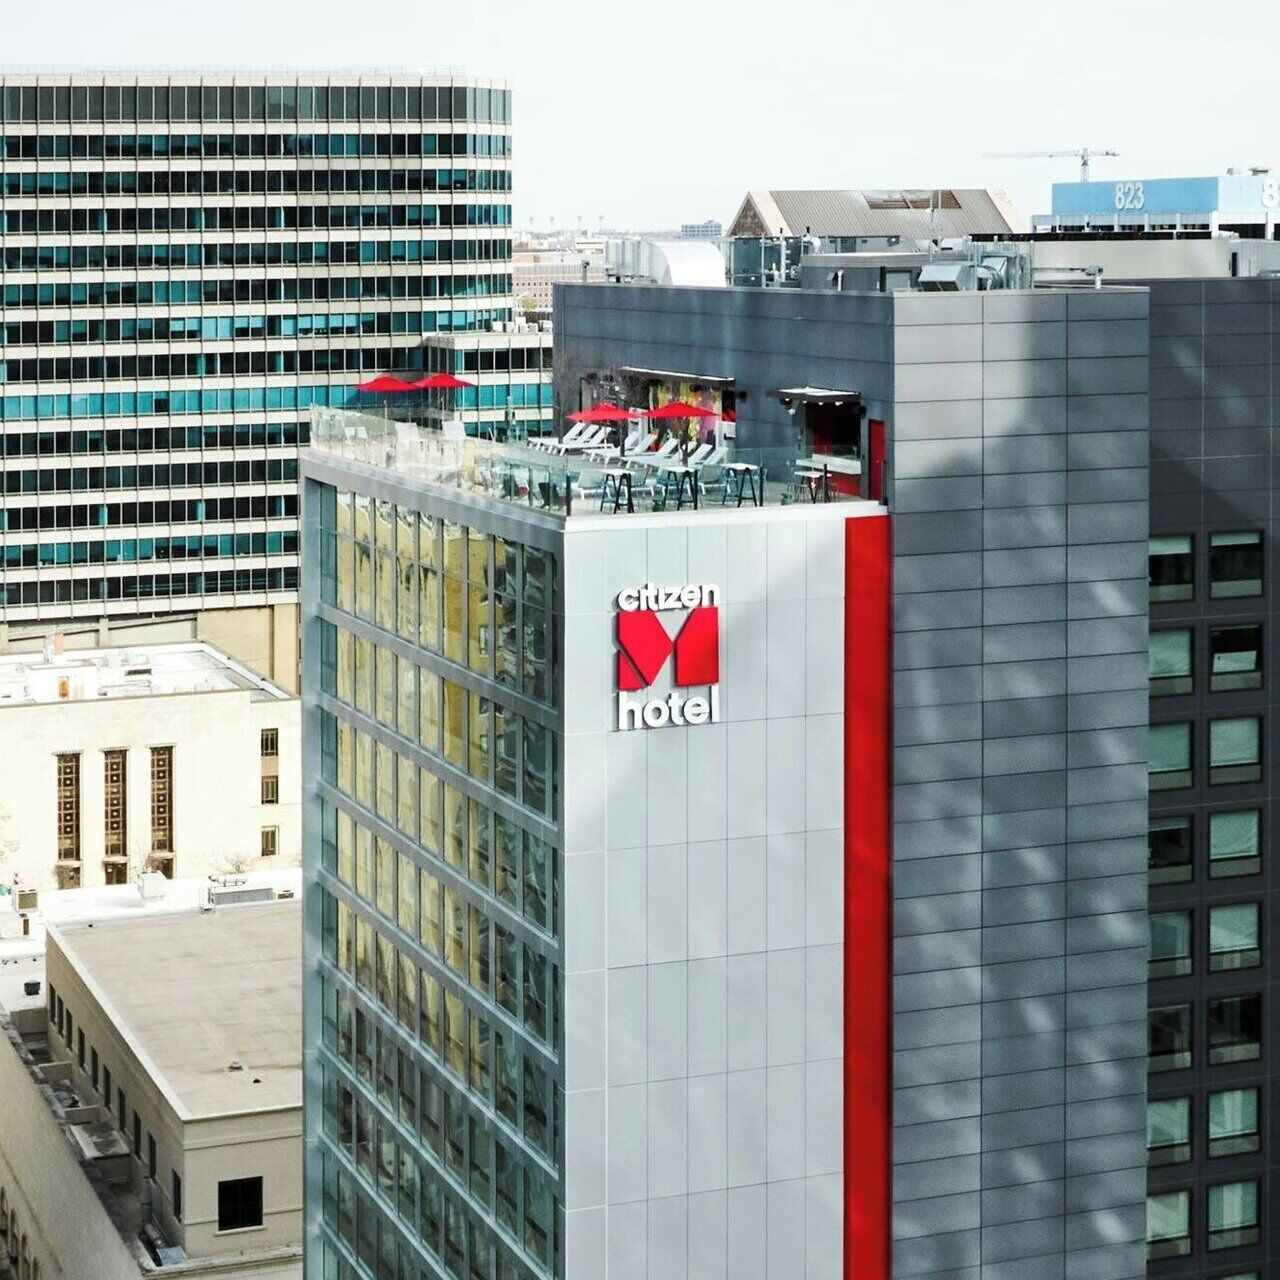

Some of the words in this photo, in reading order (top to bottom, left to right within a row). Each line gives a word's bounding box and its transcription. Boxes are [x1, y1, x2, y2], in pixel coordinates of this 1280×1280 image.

[1115, 182, 1145, 210] 823
[617, 583, 720, 613] citizen
[617, 684, 720, 730] hotel
